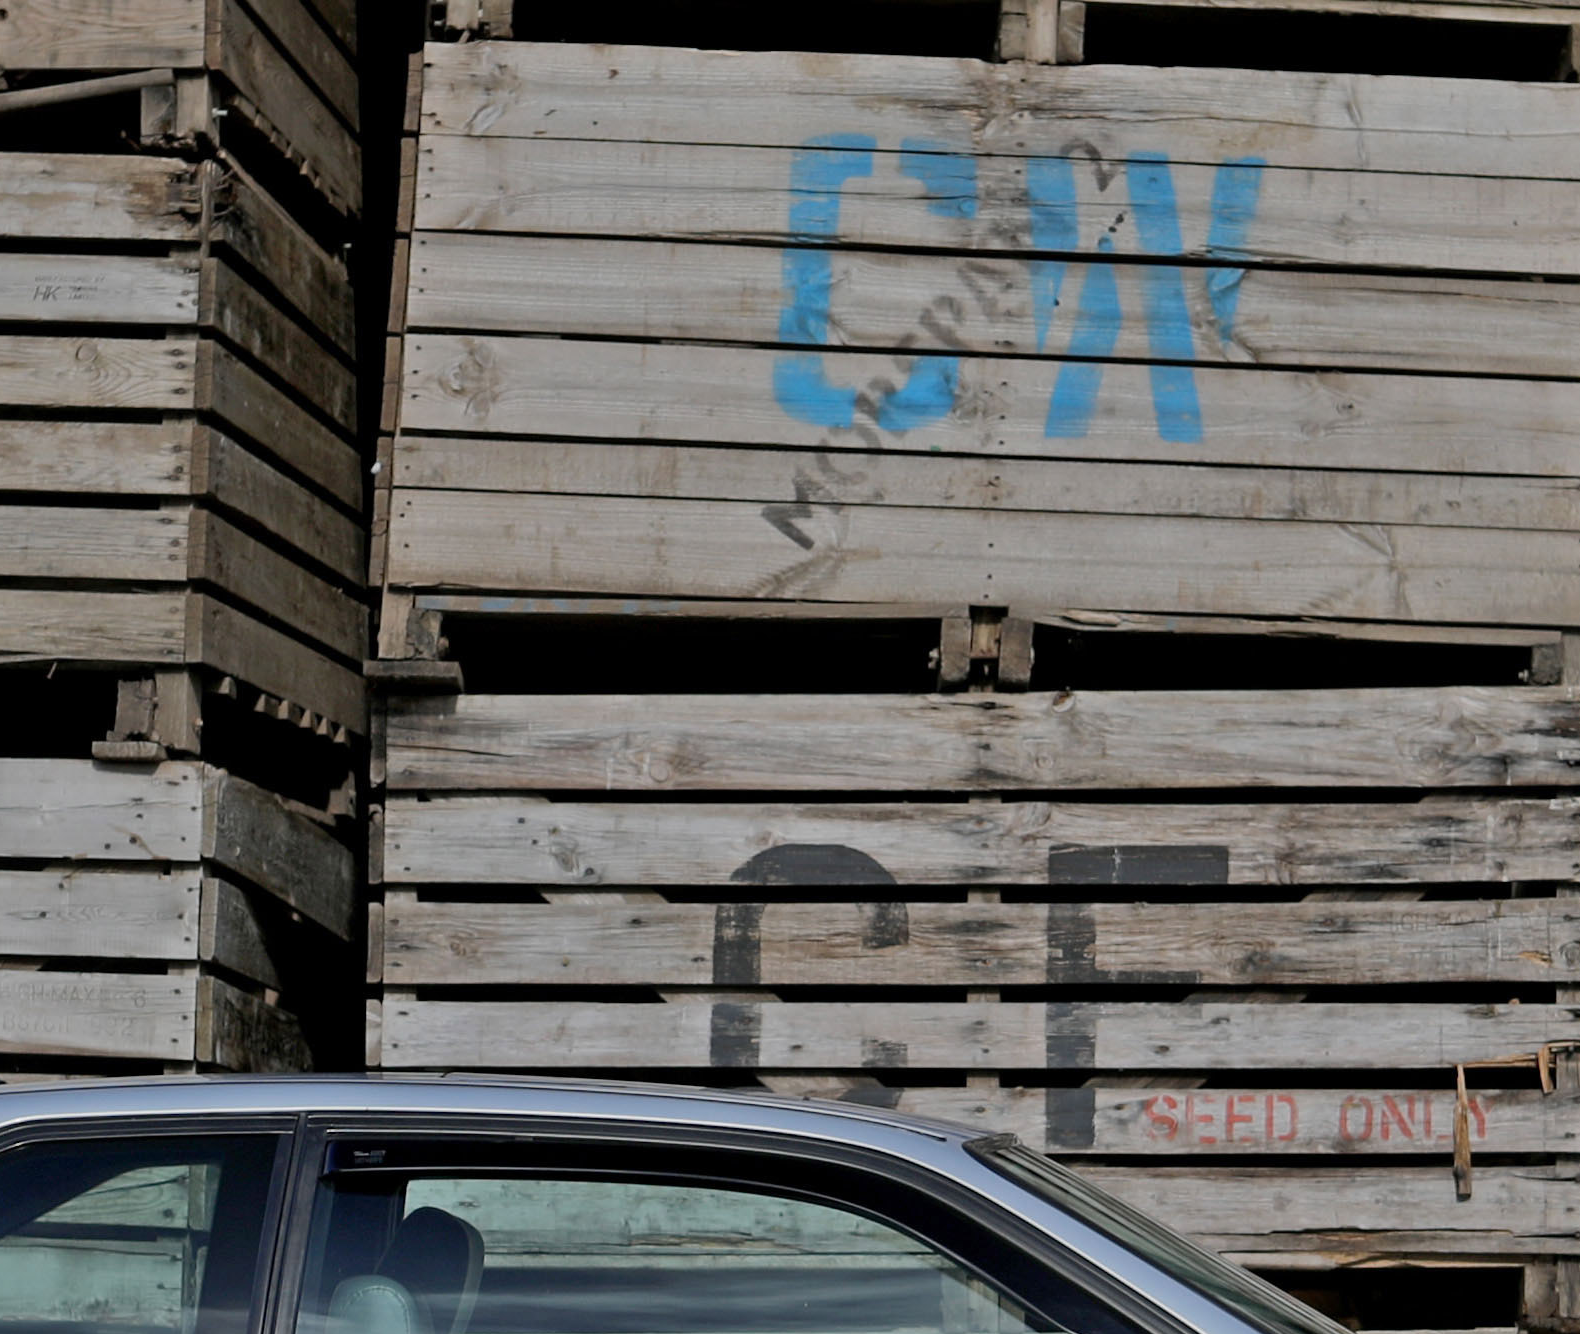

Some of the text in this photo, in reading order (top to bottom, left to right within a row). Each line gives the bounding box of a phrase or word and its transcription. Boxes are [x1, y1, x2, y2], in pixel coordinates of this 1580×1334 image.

[773, 132, 1268, 443] CW
[1145, 1094, 1492, 1144] SEED ONLY
